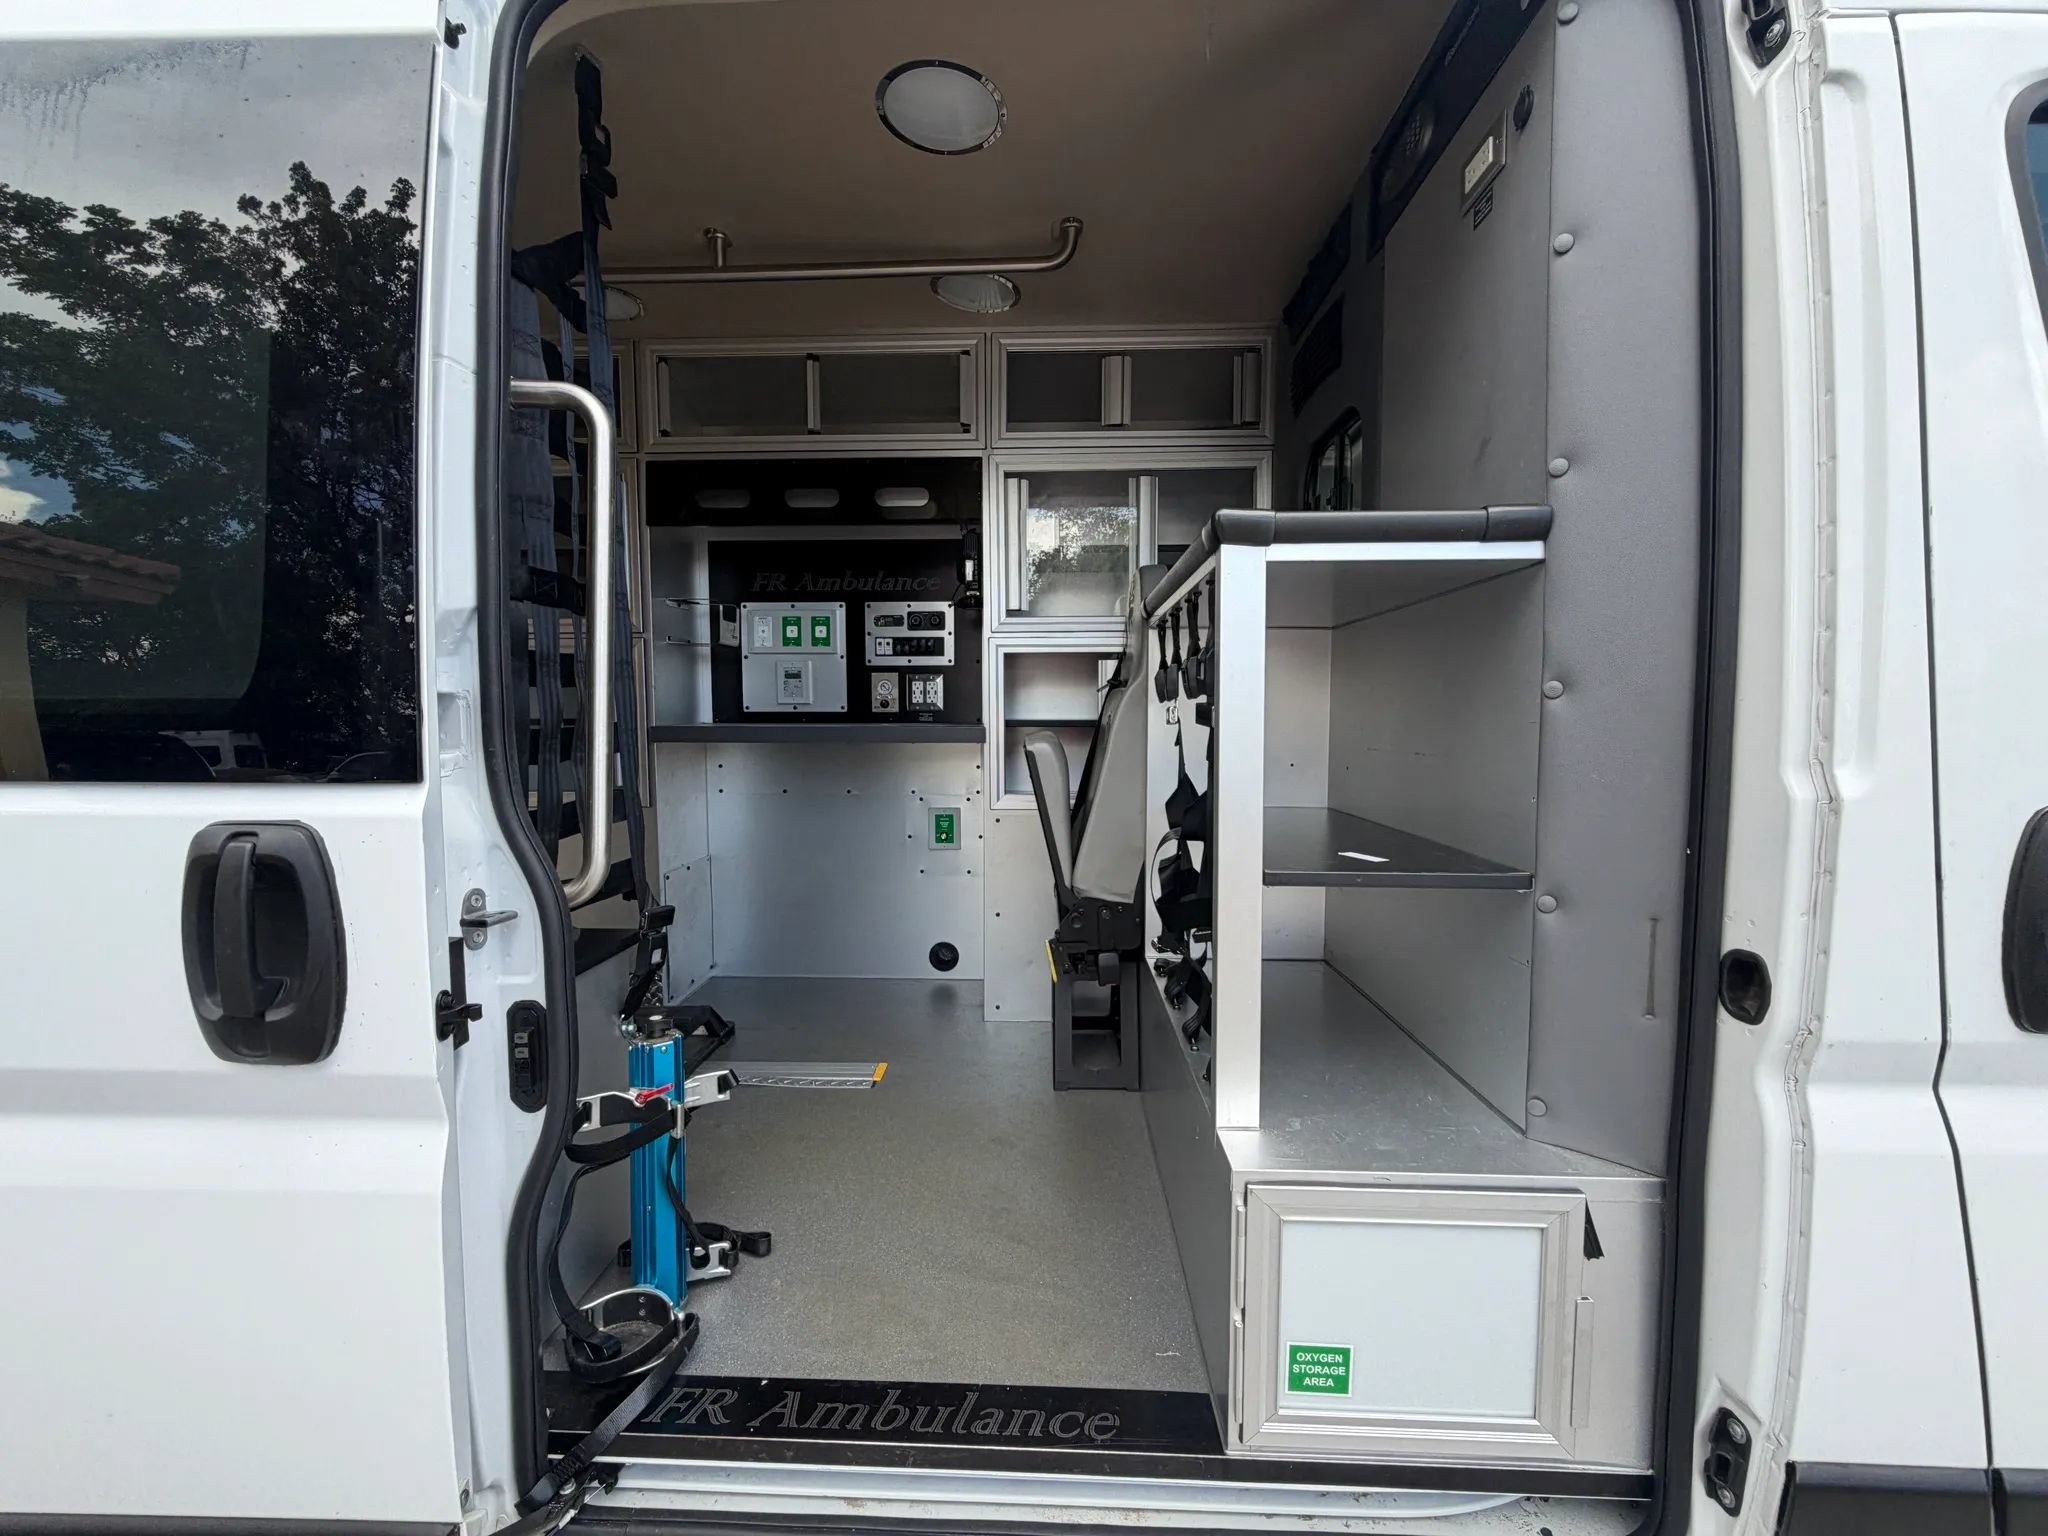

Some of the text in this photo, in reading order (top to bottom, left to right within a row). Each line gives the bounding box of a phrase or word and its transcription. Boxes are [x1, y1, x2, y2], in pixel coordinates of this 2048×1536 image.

[750, 569, 941, 593] FR Ambulance
[1296, 1352, 1343, 1363] OXYGEN
[1292, 1364, 1346, 1376] STORAGE
[1303, 1377, 1335, 1387] AREA
[640, 1386, 1122, 1440] FR Ambulance
